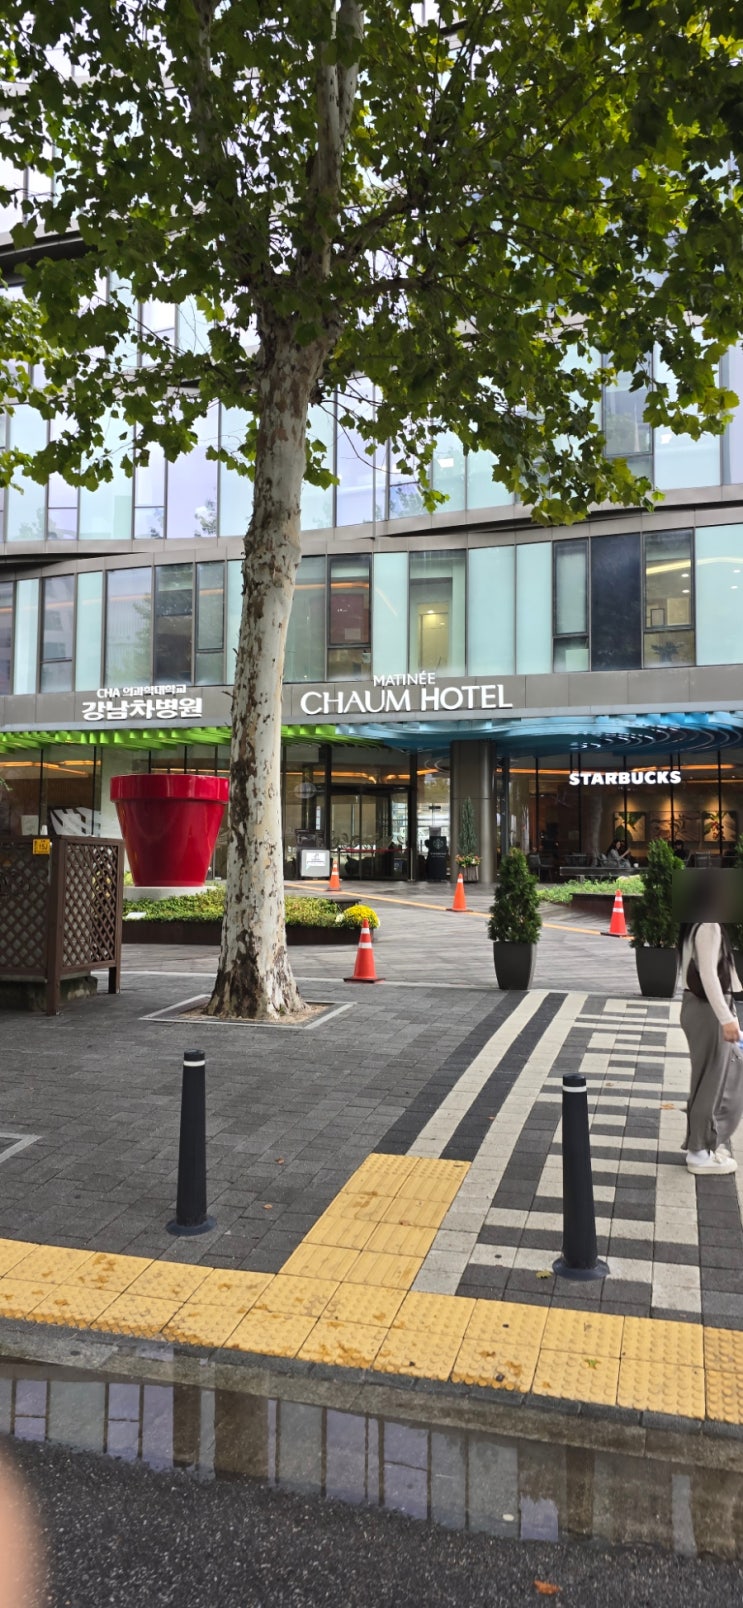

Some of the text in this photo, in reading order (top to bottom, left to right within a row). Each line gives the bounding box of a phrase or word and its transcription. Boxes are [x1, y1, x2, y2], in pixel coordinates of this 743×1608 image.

[373, 671, 436, 687] MATINÉE
[97, 684, 186, 698] CHA 의과학대학교
[300, 684, 513, 715] CHAUM HOTEL
[81, 697, 203, 721] 강남차병원
[569, 770, 682, 786] STARBUCKS
